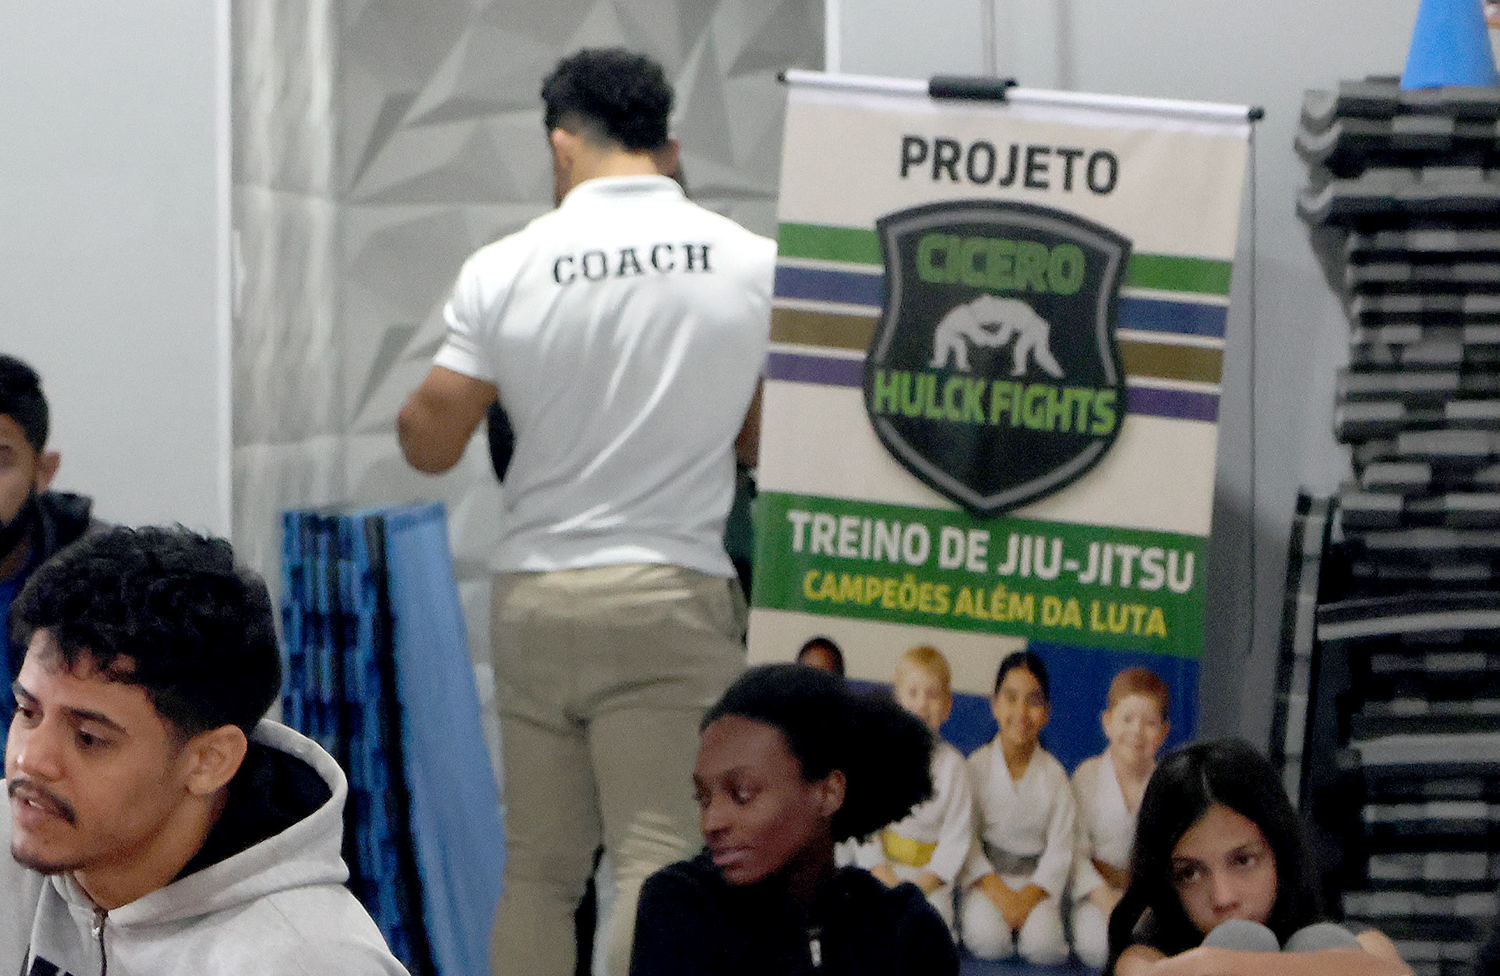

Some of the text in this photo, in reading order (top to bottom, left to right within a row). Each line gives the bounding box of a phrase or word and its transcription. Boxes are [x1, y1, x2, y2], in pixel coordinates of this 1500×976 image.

[900, 134, 1118, 194] PROJETO
[553, 243, 716, 287] COACH
[916, 232, 1085, 295] CICERO
[873, 370, 1117, 436] HULCK FIGHTS
[787, 509, 1195, 594] TREINO DE JIU-JITSU
[803, 569, 1167, 638] CAMPEÕES ALÉM DA LUTA
